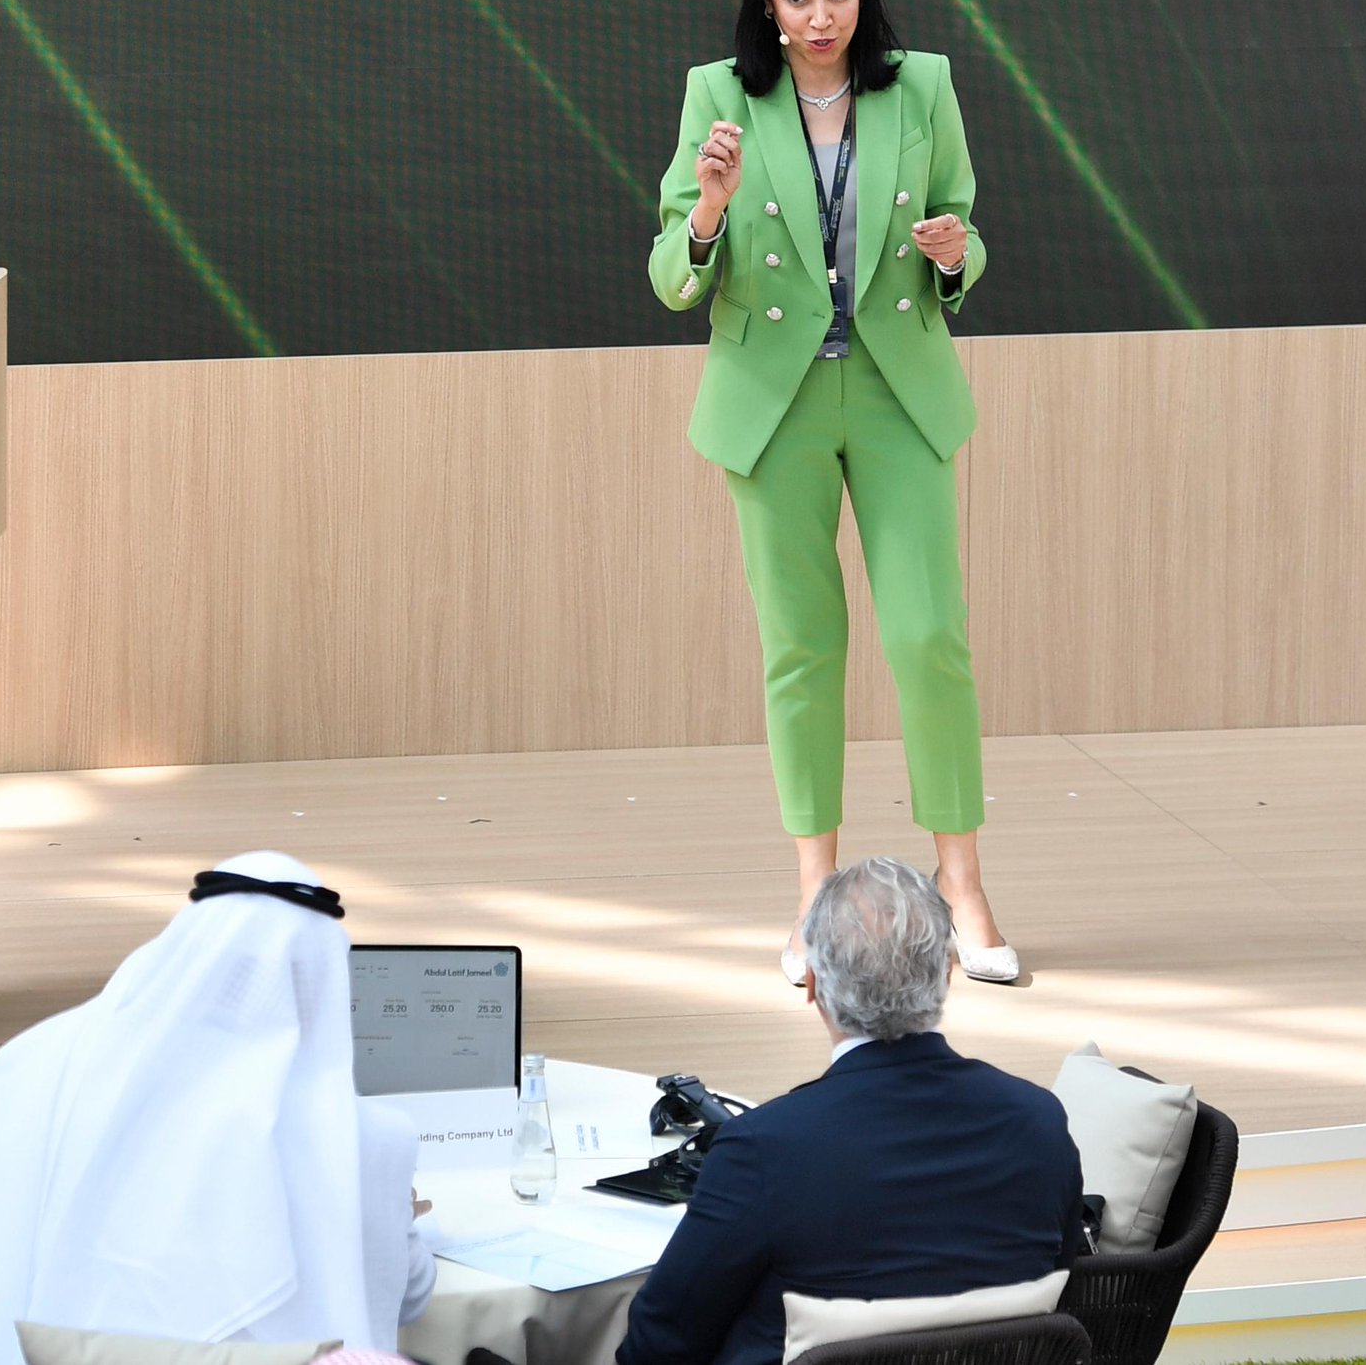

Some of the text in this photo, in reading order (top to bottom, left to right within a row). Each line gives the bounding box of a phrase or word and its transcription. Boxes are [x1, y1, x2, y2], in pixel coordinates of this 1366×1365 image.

[423, 967, 492, 978] Abdul Latif Jameel
[418, 1127, 513, 1143] lding Company Ltd
